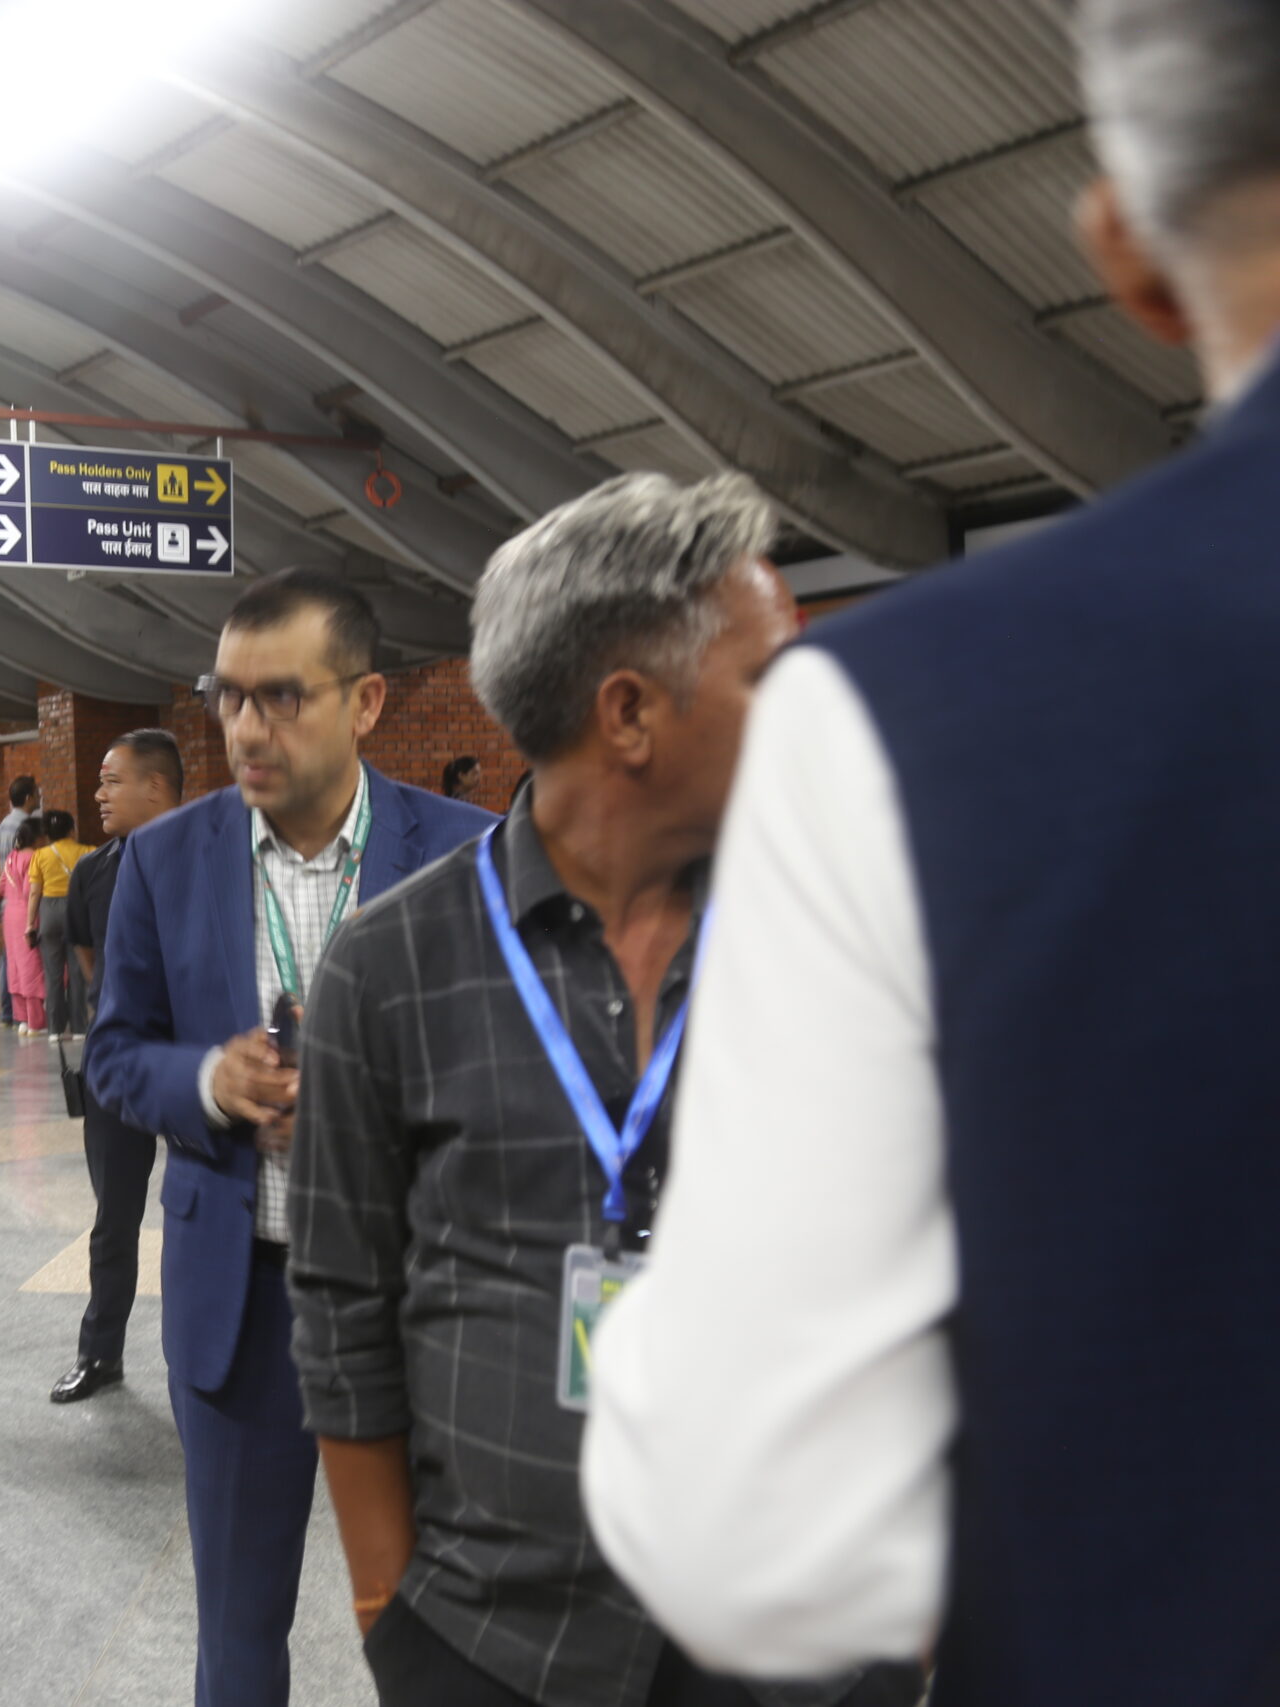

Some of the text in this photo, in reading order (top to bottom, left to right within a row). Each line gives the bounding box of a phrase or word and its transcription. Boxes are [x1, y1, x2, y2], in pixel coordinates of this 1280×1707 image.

[49, 460, 152, 483] Pass Holders Only
[87, 518, 152, 538] Pass Unit
